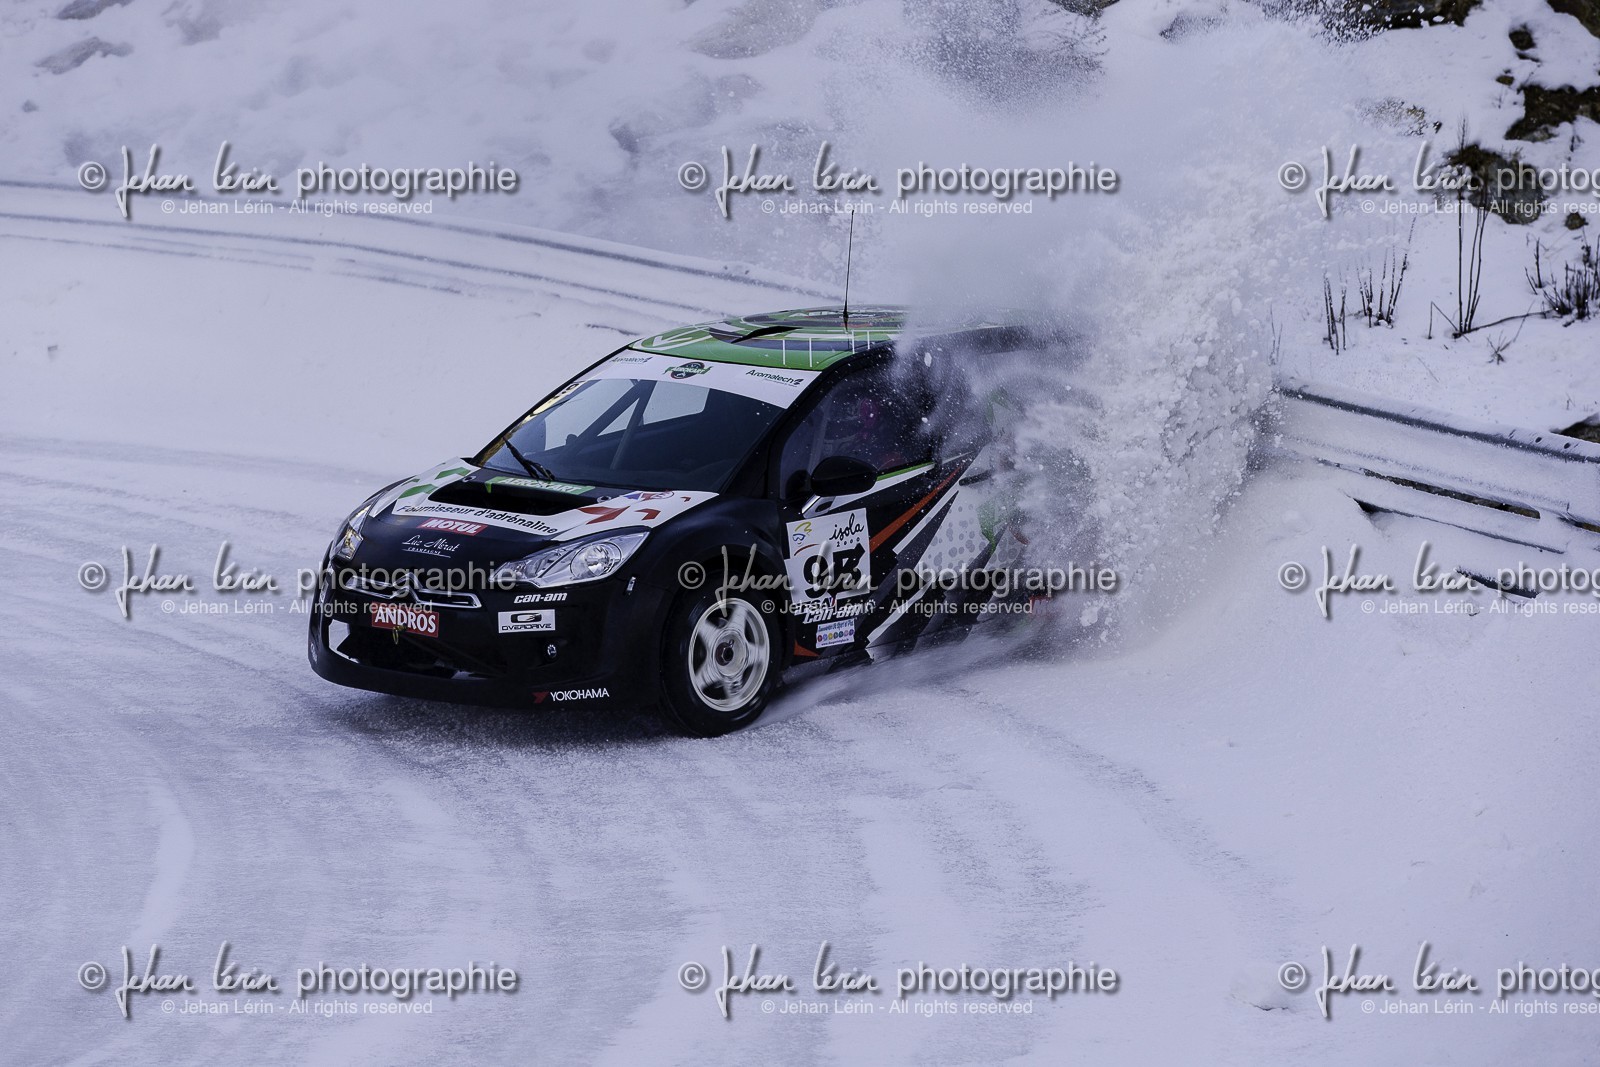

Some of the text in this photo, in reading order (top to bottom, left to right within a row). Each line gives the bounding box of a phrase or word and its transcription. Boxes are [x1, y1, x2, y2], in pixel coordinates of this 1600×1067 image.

[745, 369, 794, 384] Aromatech
[396, 503, 559, 535] Fournisseur d'adrénaline
[421, 519, 484, 534] MOTUL
[829, 512, 865, 541] isola
[513, 592, 568, 604] can-am
[374, 606, 437, 634] ANDROS
[501, 623, 552, 631] OVERDRIVE
[549, 687, 610, 702] YOKOHAMA
